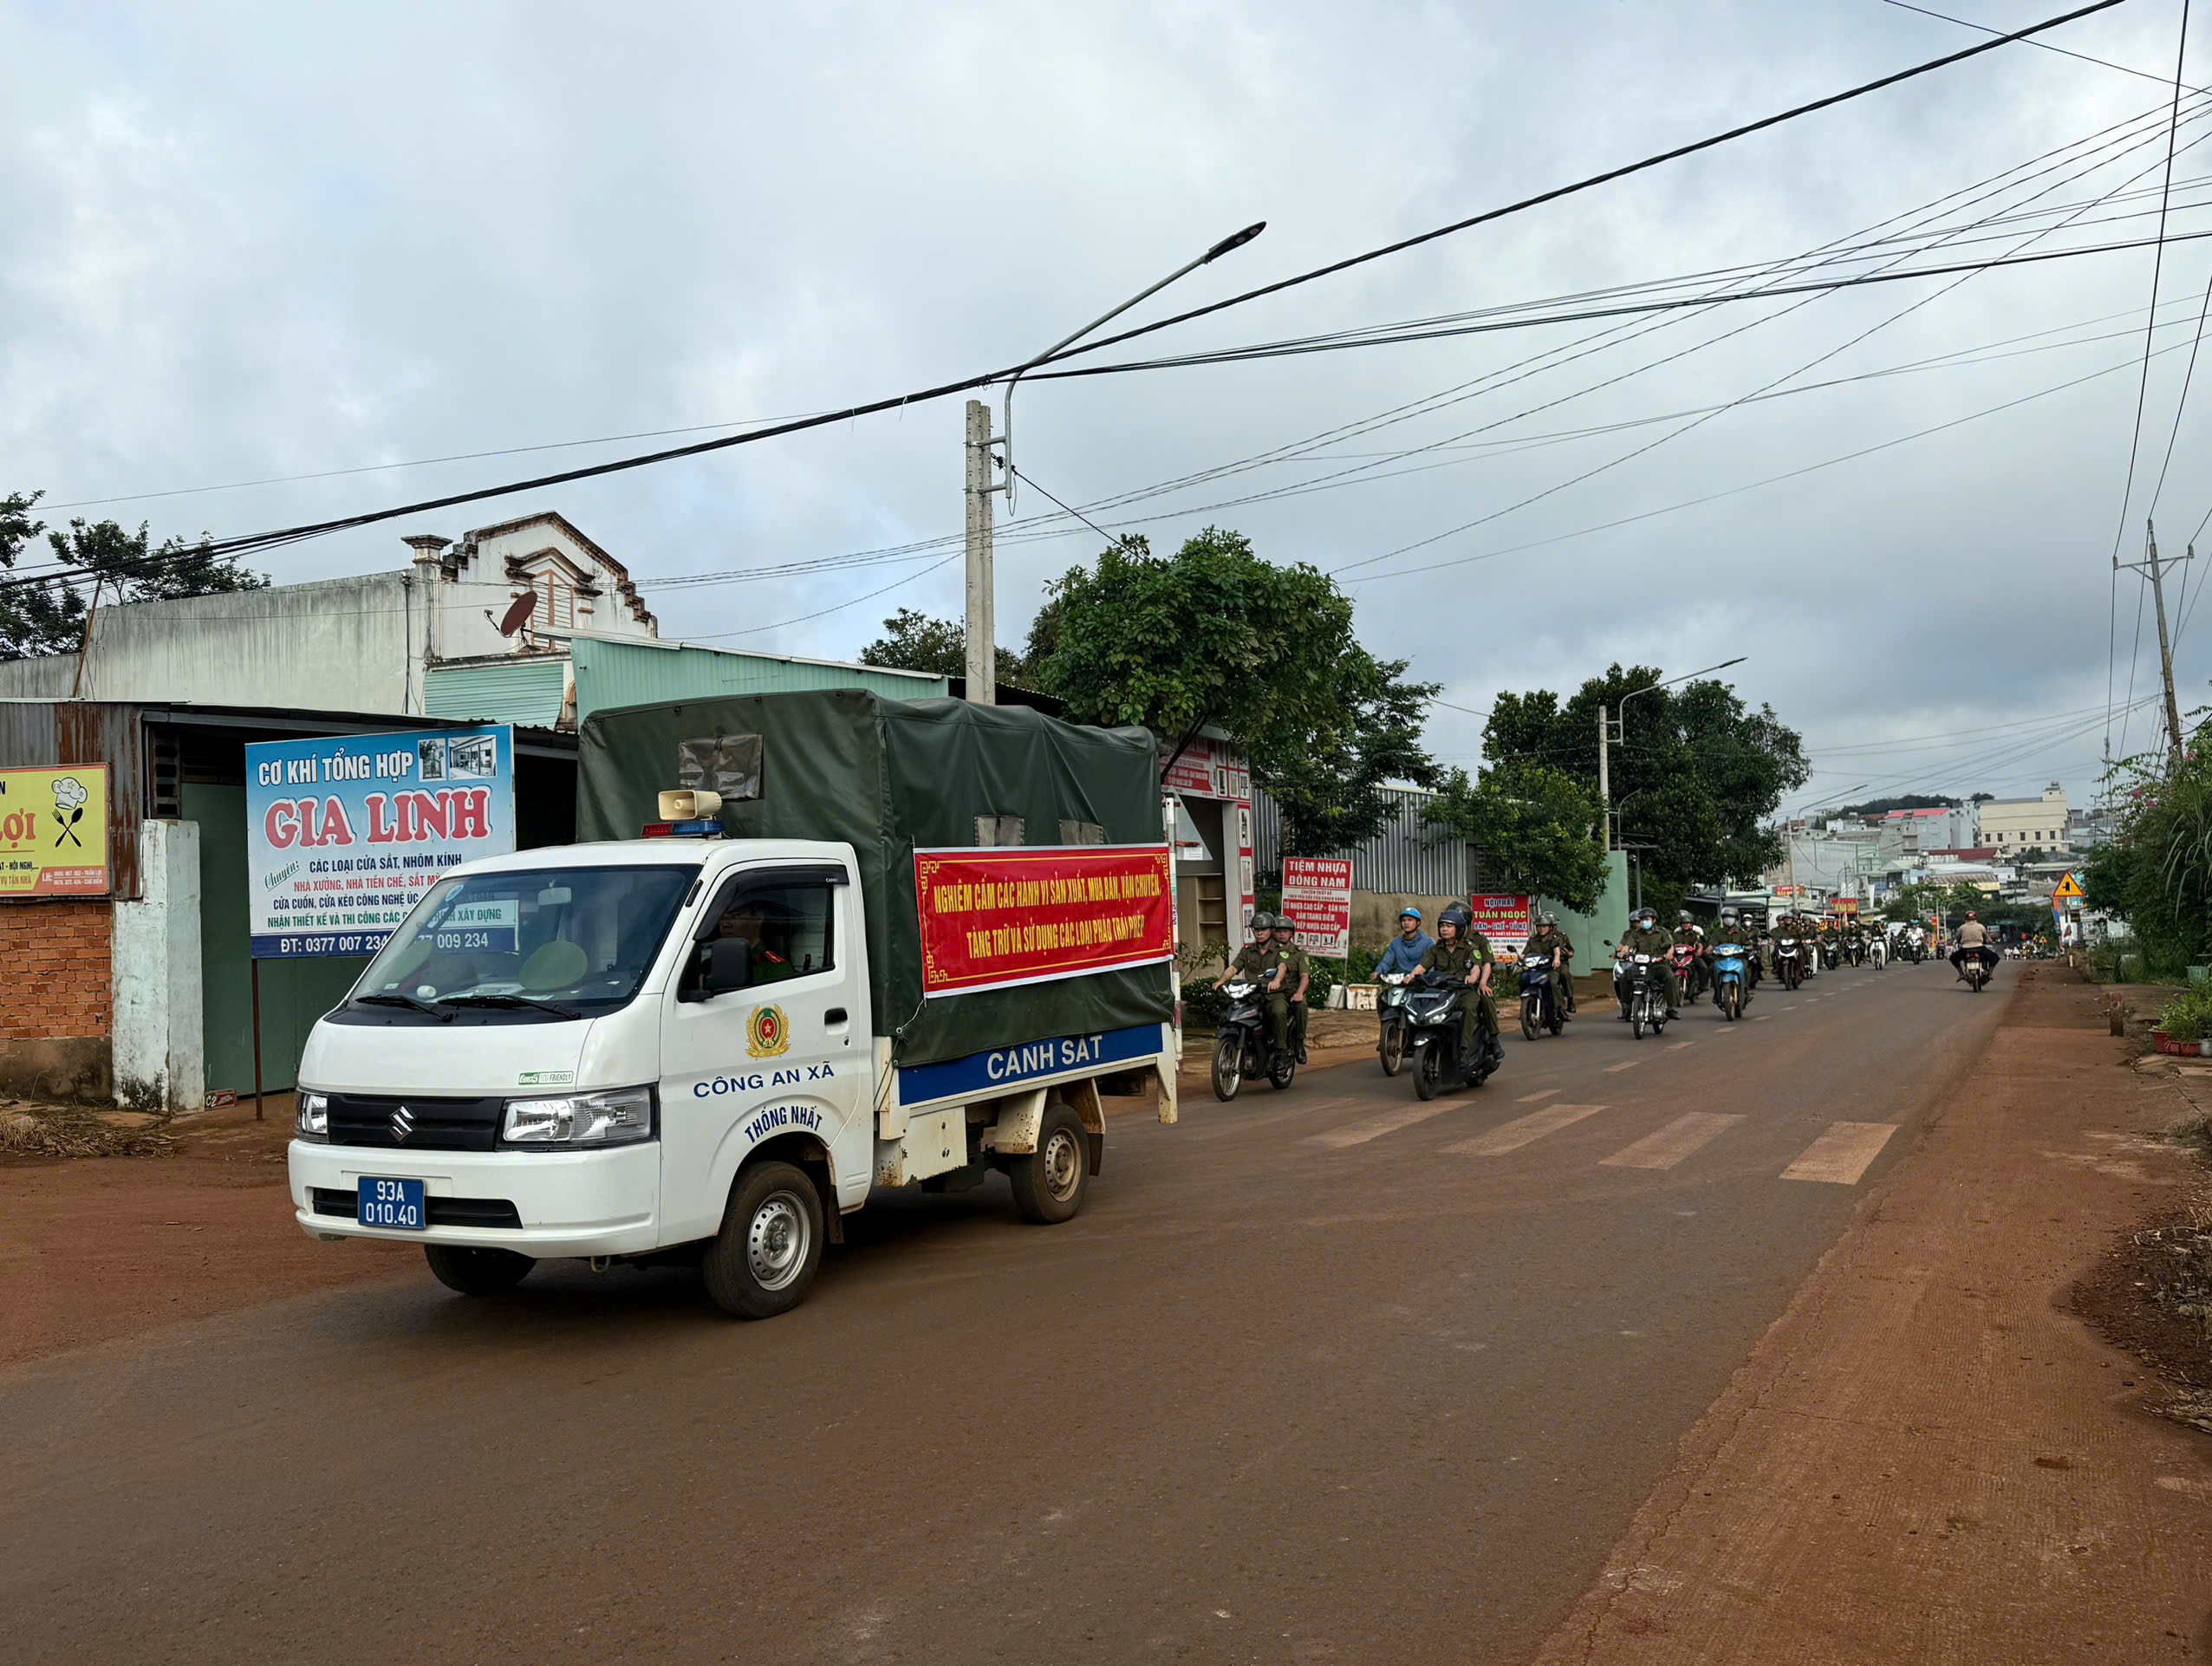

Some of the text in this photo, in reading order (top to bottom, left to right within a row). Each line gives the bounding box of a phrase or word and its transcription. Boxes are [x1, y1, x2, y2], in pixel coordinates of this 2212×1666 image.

[259, 747, 413, 786] CƠ KHÍ TỔNG HỢP
[264, 785, 491, 849] GIA LINH
[0, 807, 36, 849] ỢI
[9, 860, 18, 873] HỘI
[309, 853, 462, 874] CÁC LOẠI CỬA SẮT, NHÔM KÍNH
[1289, 859, 1347, 875] TIỆM NHỰA
[20, 874, 31, 884] NHÀ
[294, 878, 311, 892] NHÀ
[347, 875, 363, 889] NHÀ
[387, 874, 406, 888] CHẾ,
[408, 872, 425, 887] SẮT
[1321, 876, 1345, 888] NAM
[274, 895, 290, 910] CỬA
[319, 894, 335, 908] CỬA
[338, 894, 354, 907] KÉO
[357, 893, 380, 907] CÔNG
[382, 892, 405, 907] NGHỆ
[407, 891, 419, 904] ÚC
[934, 878, 973, 914] NGHIÊM
[975, 874, 996, 910] CẤM
[998, 876, 1014, 908] CÁC
[1017, 875, 1039, 908] HÀNH
[1040, 881, 1049, 905] VI
[1051, 870, 1066, 905] SẢN
[1088, 877, 1103, 901] MUA
[1103, 871, 1121, 901] BÁN,
[1121, 869, 1135, 904] VẬN
[1484, 897, 1515, 908] NỘI THẤT
[268, 914, 290, 929] NHẬN
[293, 912, 314, 926] THIẾT
[316, 912, 327, 926] KẾ
[329, 912, 340, 925] VÀ
[342, 914, 355, 924] THI
[358, 911, 380, 924] CÔNG
[383, 910, 400, 923] CÁC
[458, 908, 474, 921] XÂY
[478, 908, 502, 922] DỰNG
[1474, 909, 1526, 920] TUẤN NGỌC
[280, 939, 302, 953] ĐT:
[306, 937, 335, 952] 0377
[339, 936, 361, 951] 007
[366, 935, 389, 950] 234
[437, 934, 460, 948] 009
[465, 932, 489, 947] 234
[966, 925, 992, 959] TÀNG
[992, 923, 1011, 956] TRỮ
[1011, 922, 1022, 953] VÀ
[1024, 916, 1036, 953] SỬ
[1036, 923, 1058, 956] DỤNG
[1060, 916, 1075, 947] CÁC
[1076, 920, 1092, 950] LOẠI
[1092, 913, 1112, 944] PHÁO
[1112, 911, 1128, 941] TRÁI
[1128, 909, 1144, 940] PHÉP
[1062, 1034, 1103, 1065] SÁT
[693, 1061, 835, 1098] CÔNG AN XÃ
[745, 1105, 823, 1143] THỐNG NHẤT
[377, 1181, 405, 1201] 93A
[366, 1202, 416, 1226] 010.40
